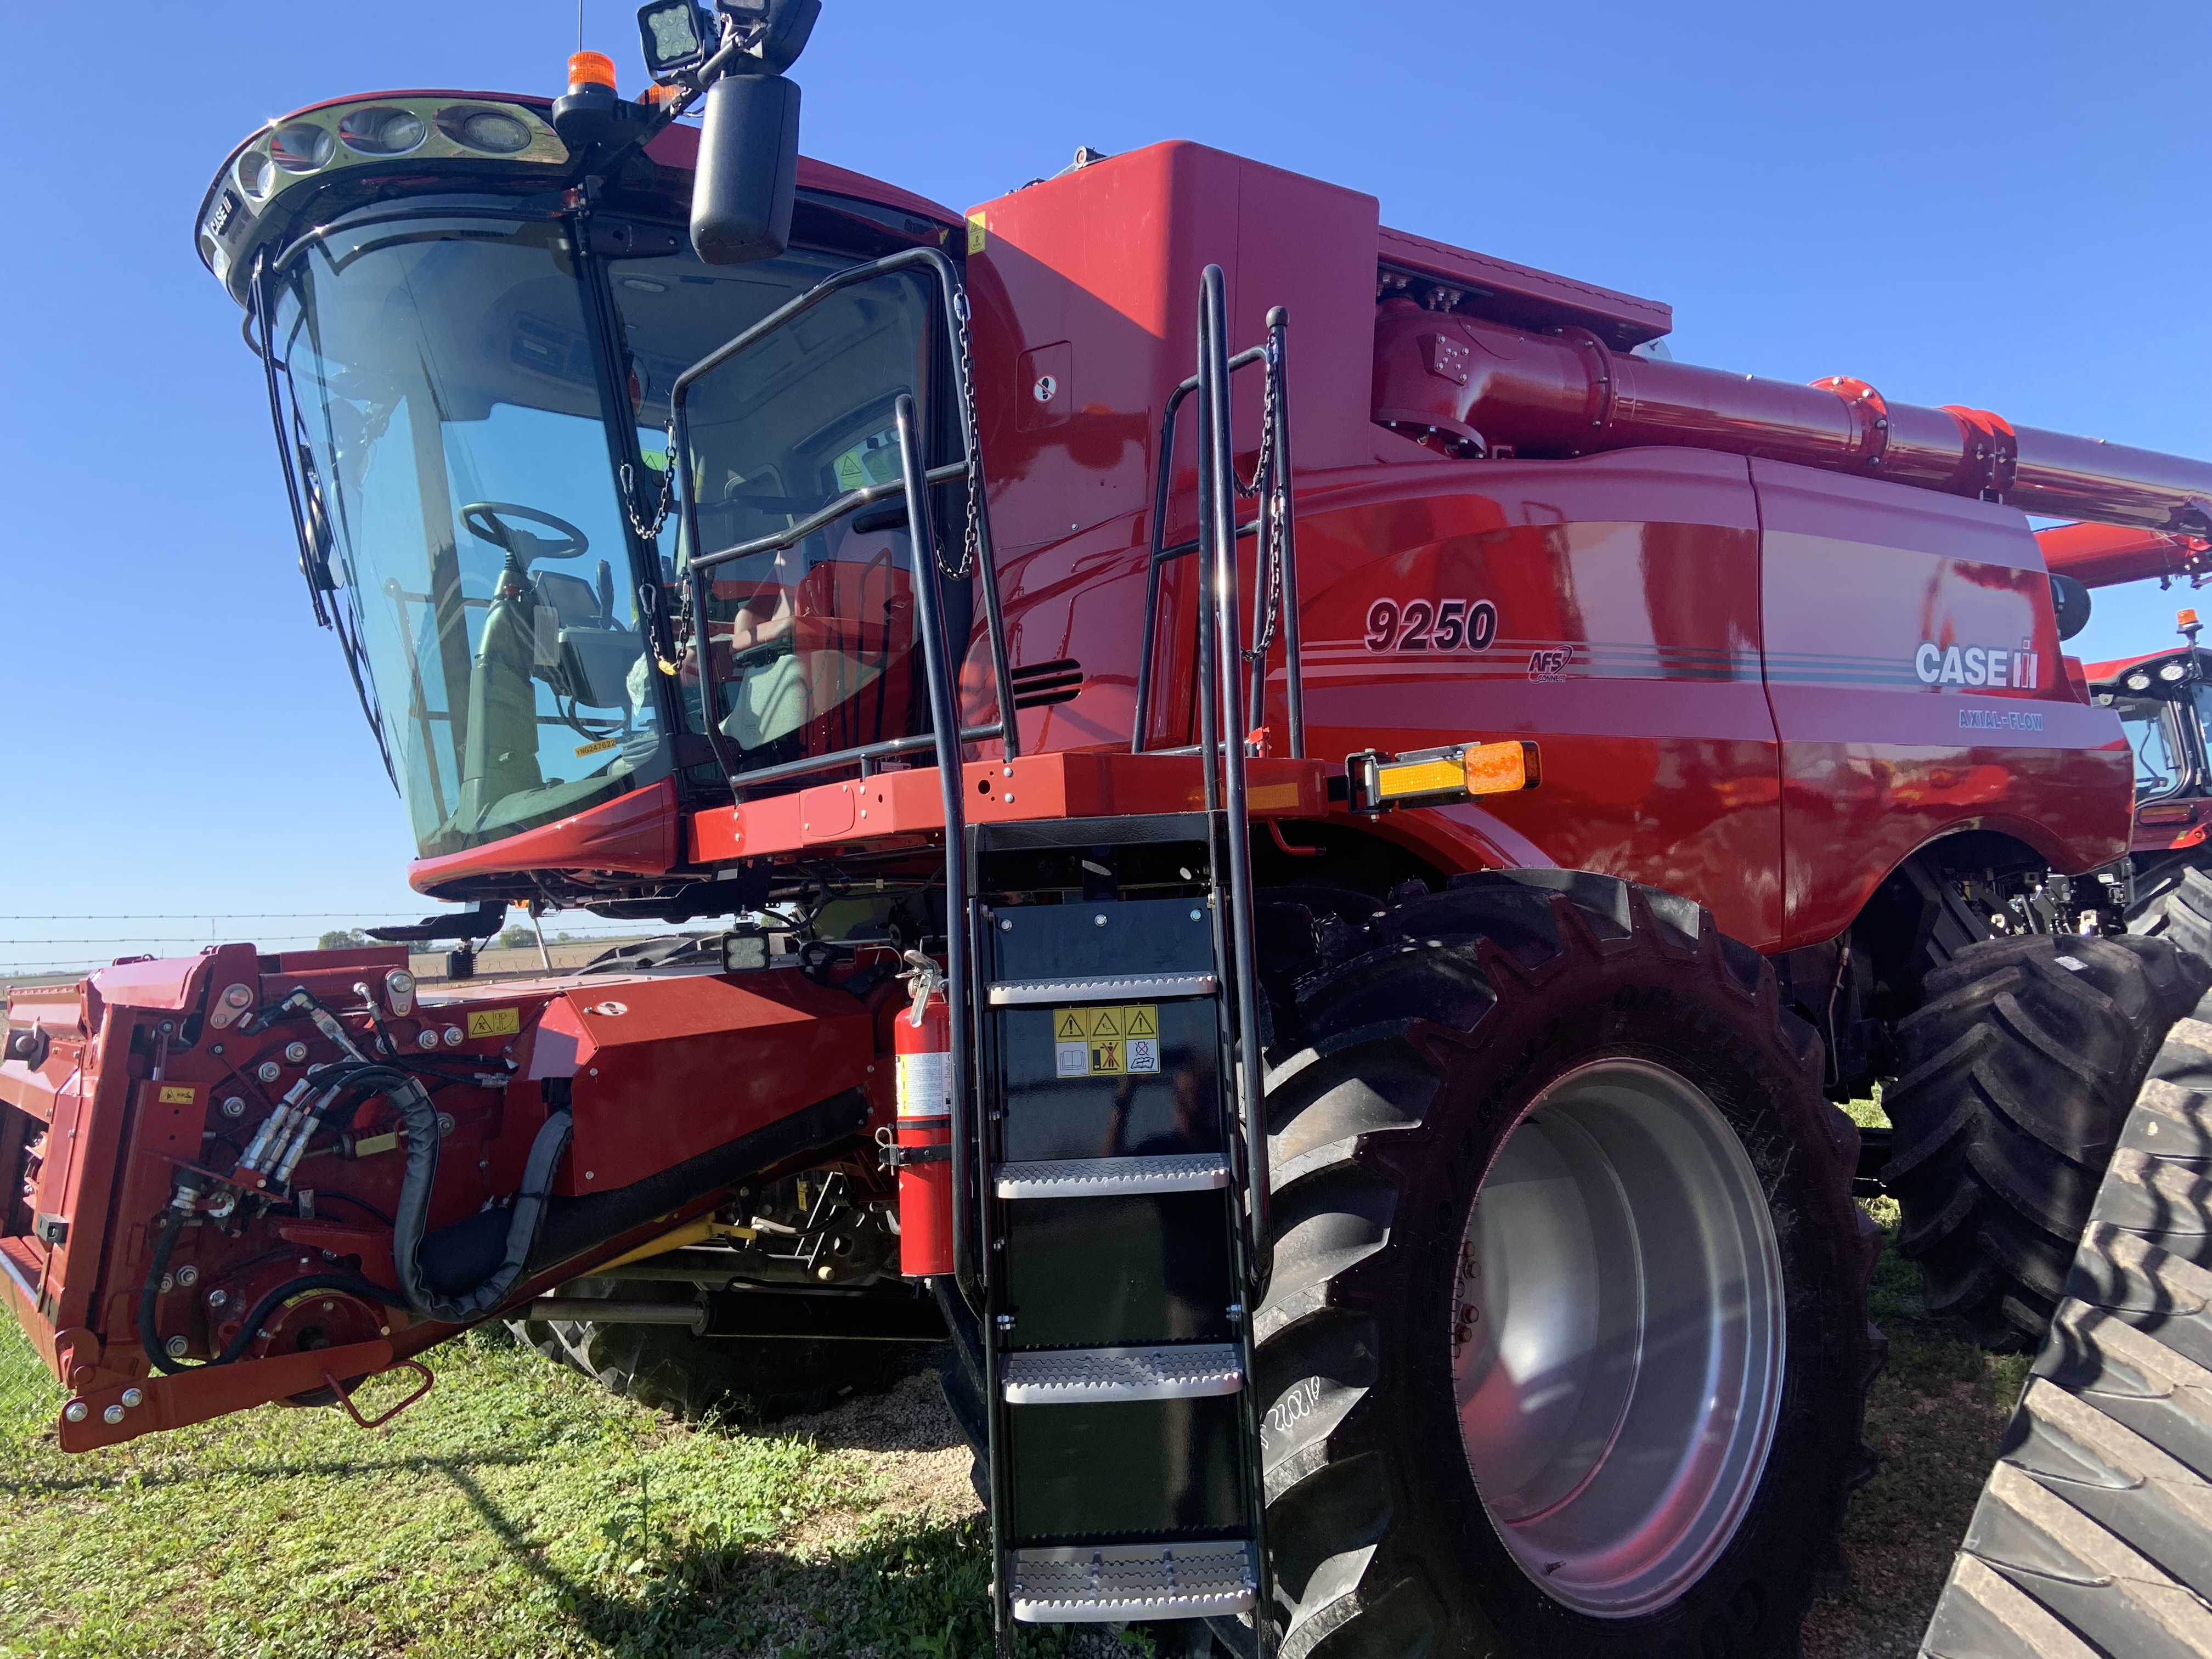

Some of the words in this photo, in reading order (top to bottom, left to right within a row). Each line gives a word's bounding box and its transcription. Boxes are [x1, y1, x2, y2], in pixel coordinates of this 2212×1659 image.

[210, 205, 228, 236] CASE
[1364, 597, 1498, 654] 9250
[1527, 650, 1564, 673] AFS
[1915, 643, 2008, 687] CASE
[1538, 674, 1567, 683] CONNECT
[1959, 709, 2044, 732] AXIAL-FLOW
[575, 739, 616, 757] YNG247622
[902, 1061, 905, 1070] A
[902, 1081, 906, 1090] B
[903, 1101, 906, 1109] C
